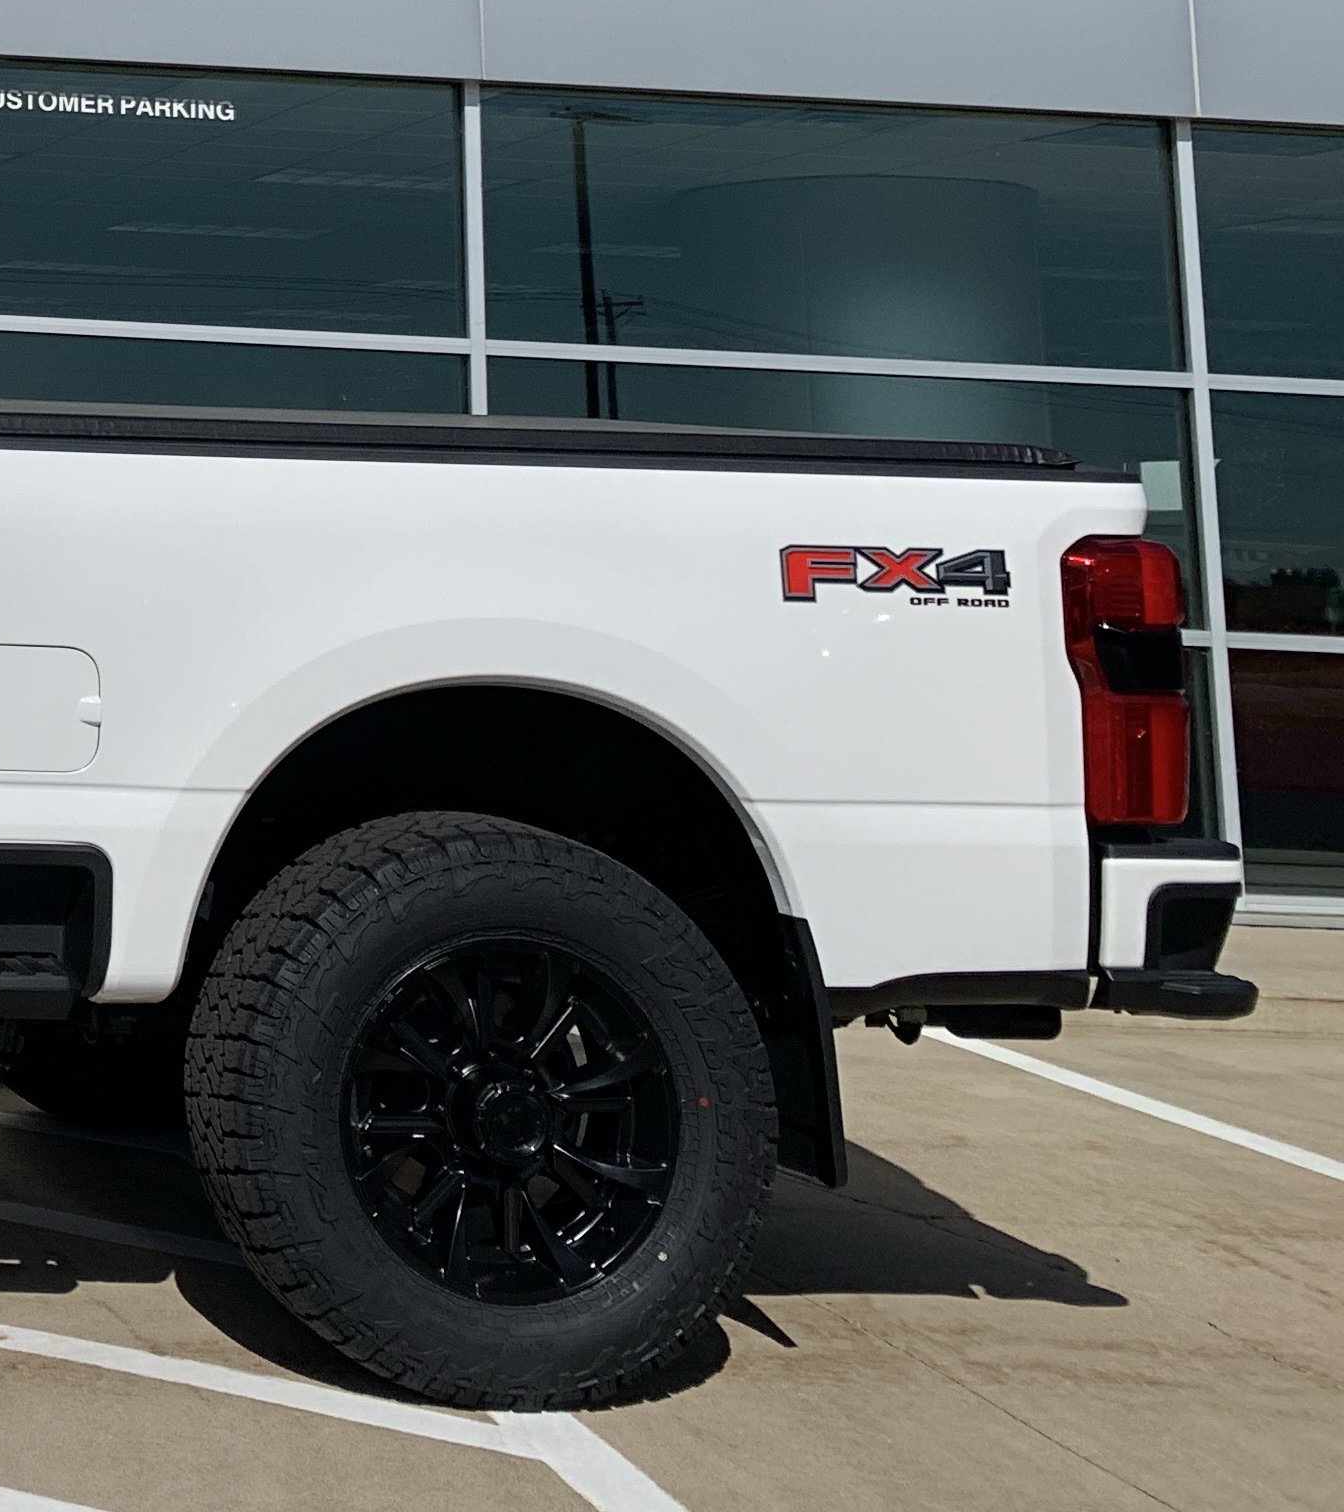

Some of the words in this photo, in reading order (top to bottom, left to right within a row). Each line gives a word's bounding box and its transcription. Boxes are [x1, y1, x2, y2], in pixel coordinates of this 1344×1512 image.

[120, 96, 235, 121] PARKING
[779, 544, 1012, 603] FX4
[910, 596, 950, 607] OFF
[957, 598, 1010, 608] ROAD
